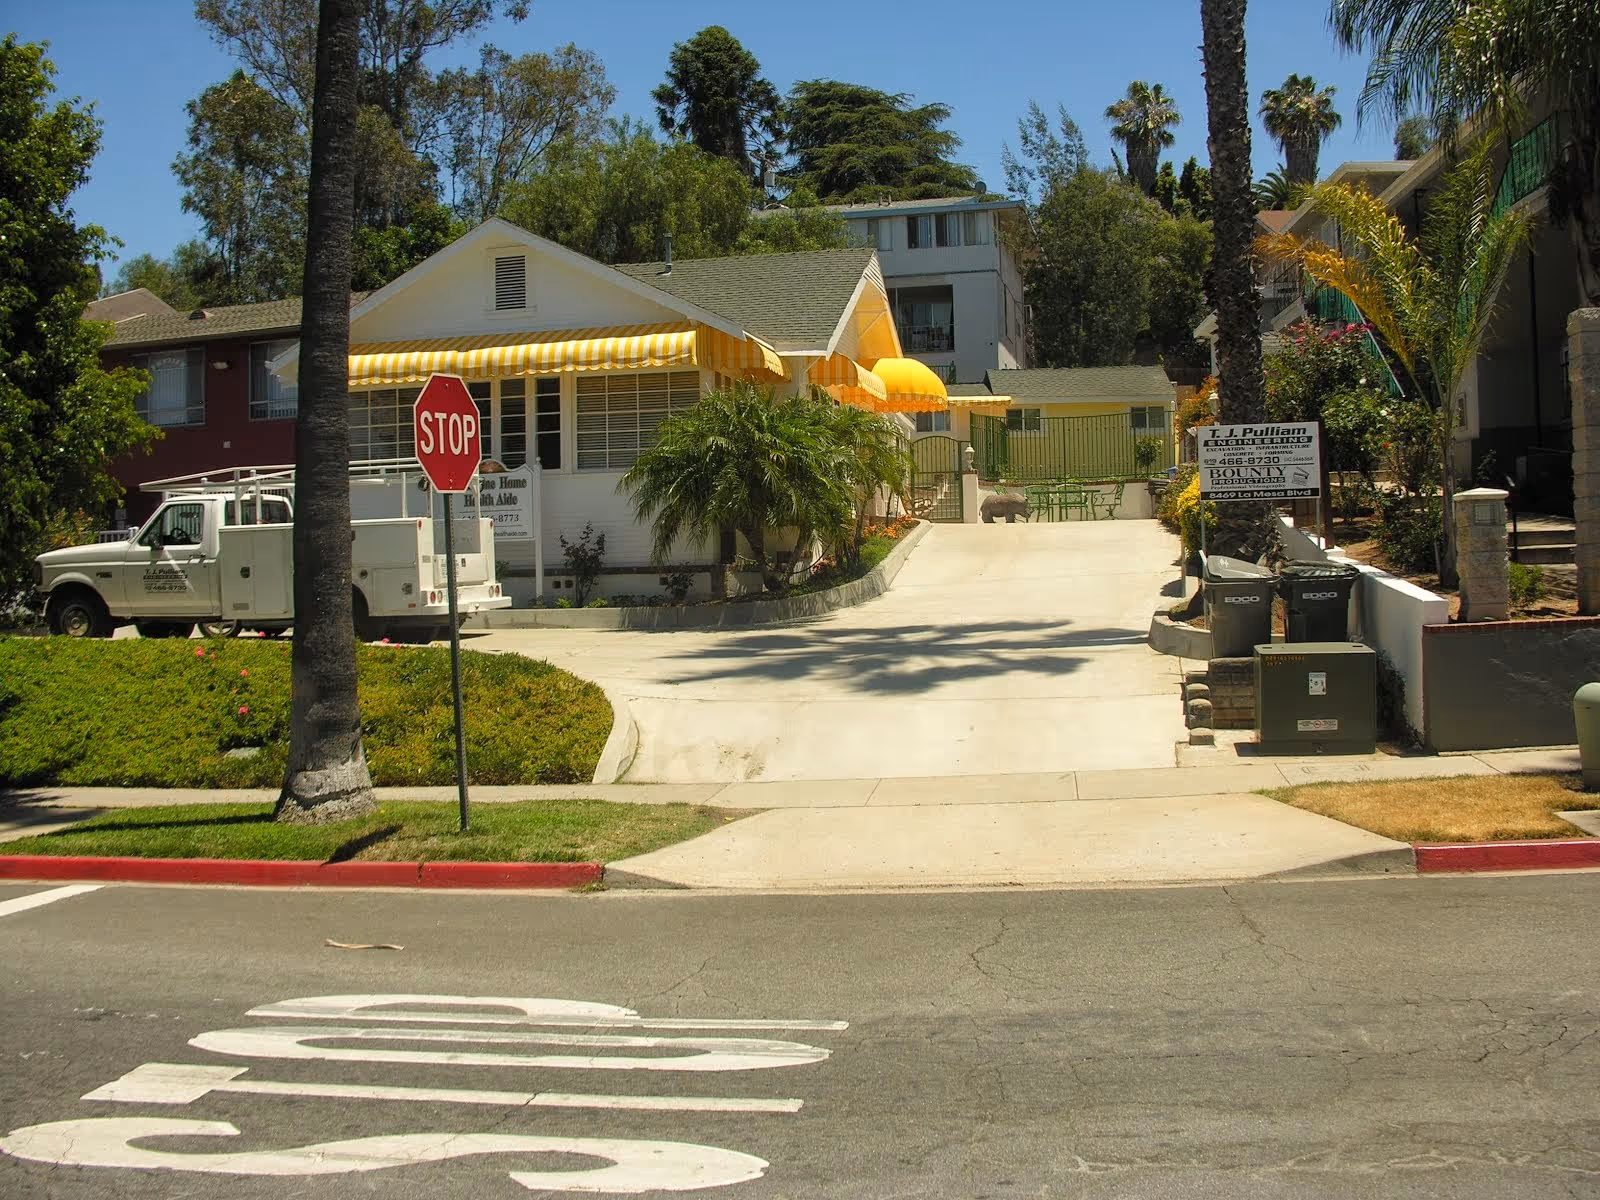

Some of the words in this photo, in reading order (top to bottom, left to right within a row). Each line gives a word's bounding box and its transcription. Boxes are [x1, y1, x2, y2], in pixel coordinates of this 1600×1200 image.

[420, 410, 476, 455] STOP
[1209, 428, 1220, 438] T.
[1225, 428, 1238, 438] J.
[1242, 426, 1306, 438] Pulliam
[1207, 436, 1309, 446] ENGINEERING
[1219, 456, 1280, 466] 466-8730
[1209, 466, 1287, 479] BOUNTY
[499, 476, 528, 489] Home
[1212, 477, 1285, 485] PRODUCTIONS
[464, 493, 494, 507] Helth
[496, 492, 518, 506] Aide
[1209, 491, 1236, 499] 8469
[1287, 489, 1312, 497] Blvd
[1302, 591, 1338, 599] EDCO
[0, 994, 849, 1193] STOP
